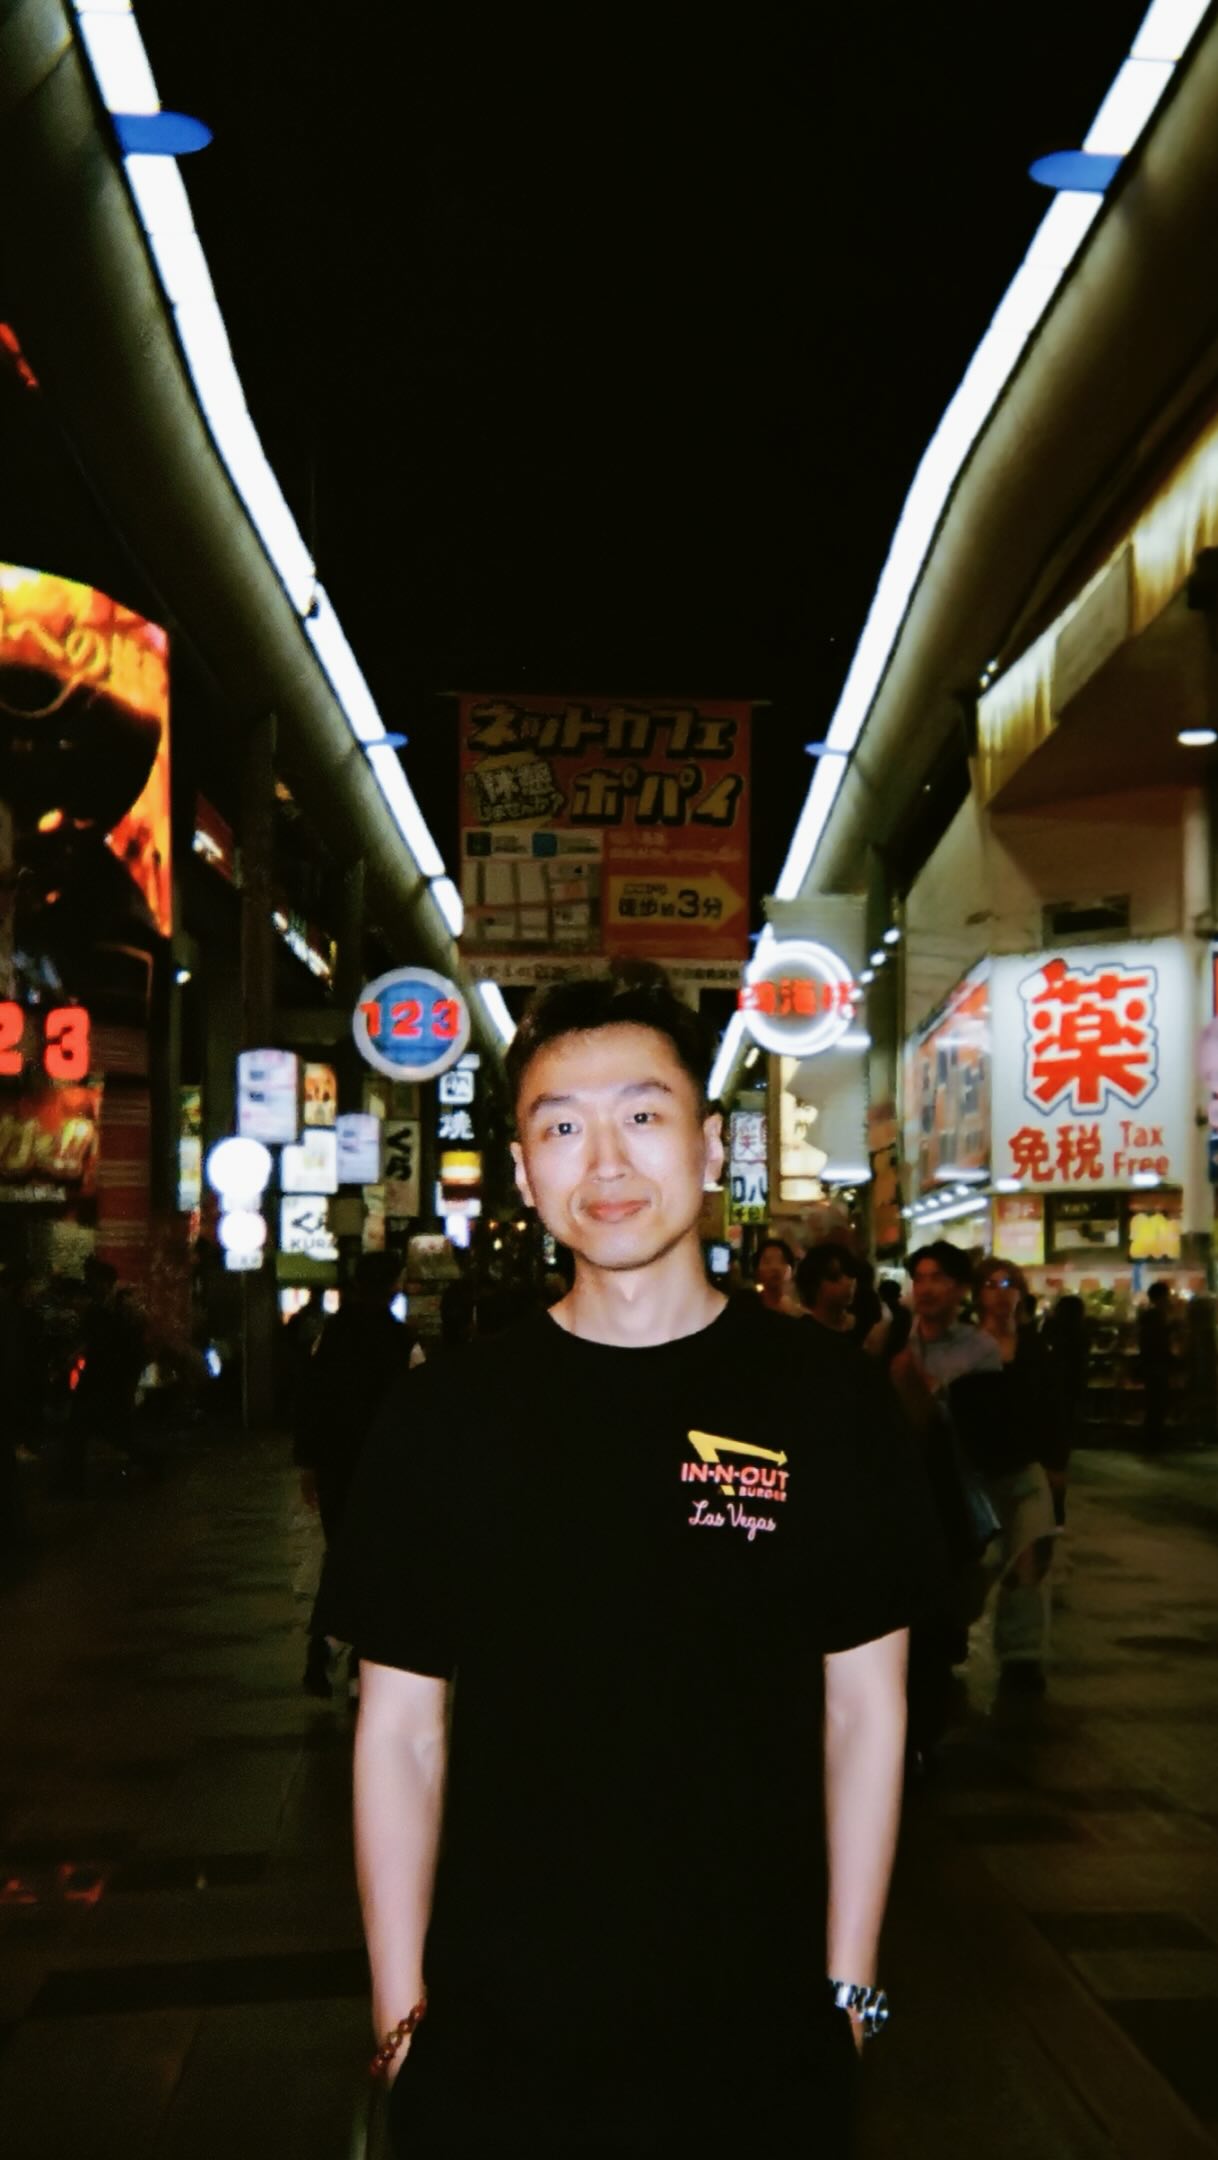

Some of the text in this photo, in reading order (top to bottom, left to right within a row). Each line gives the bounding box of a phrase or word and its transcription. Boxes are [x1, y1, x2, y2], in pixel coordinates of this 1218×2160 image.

[469, 702, 736, 757] ネットカフェ
[571, 764, 742, 824] ポパイ
[360, 998, 461, 1040] 123
[1030, 958, 1150, 1104] 薬
[1009, 1122, 1104, 1183] 免税
[1119, 1120, 1165, 1147] Tax
[1113, 1152, 1170, 1177] Free
[680, 1462, 790, 1489] IN-N-OUT
[738, 1486, 788, 1502] BURGER
[688, 1500, 777, 1542] Las Vegas
